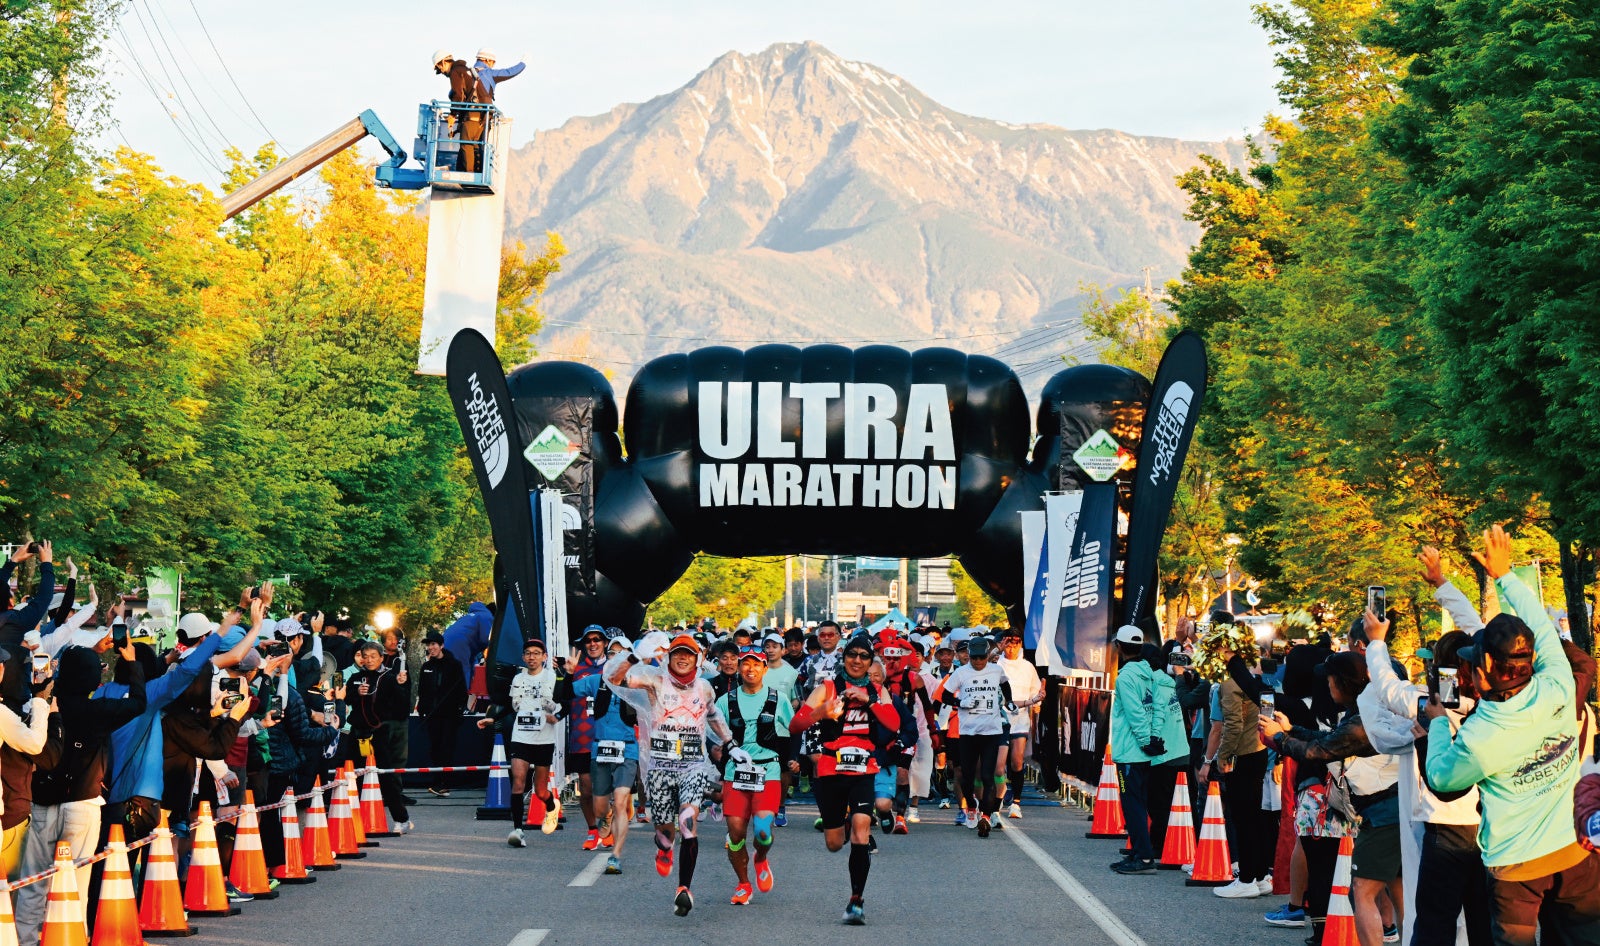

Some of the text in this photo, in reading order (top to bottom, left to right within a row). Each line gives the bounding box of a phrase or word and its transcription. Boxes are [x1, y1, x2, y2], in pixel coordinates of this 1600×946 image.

[466, 400, 489, 454] FACE
[468, 371, 499, 446] NORTH
[486, 392, 506, 433] THE
[698, 381, 956, 461] ULTRA
[1152, 404, 1169, 445] THE
[1149, 410, 1178, 486] NORTH
[1161, 425, 1183, 475] FACE
[699, 463, 956, 510] MARATHON
[1513, 749, 1574, 786] NOBEYAM
